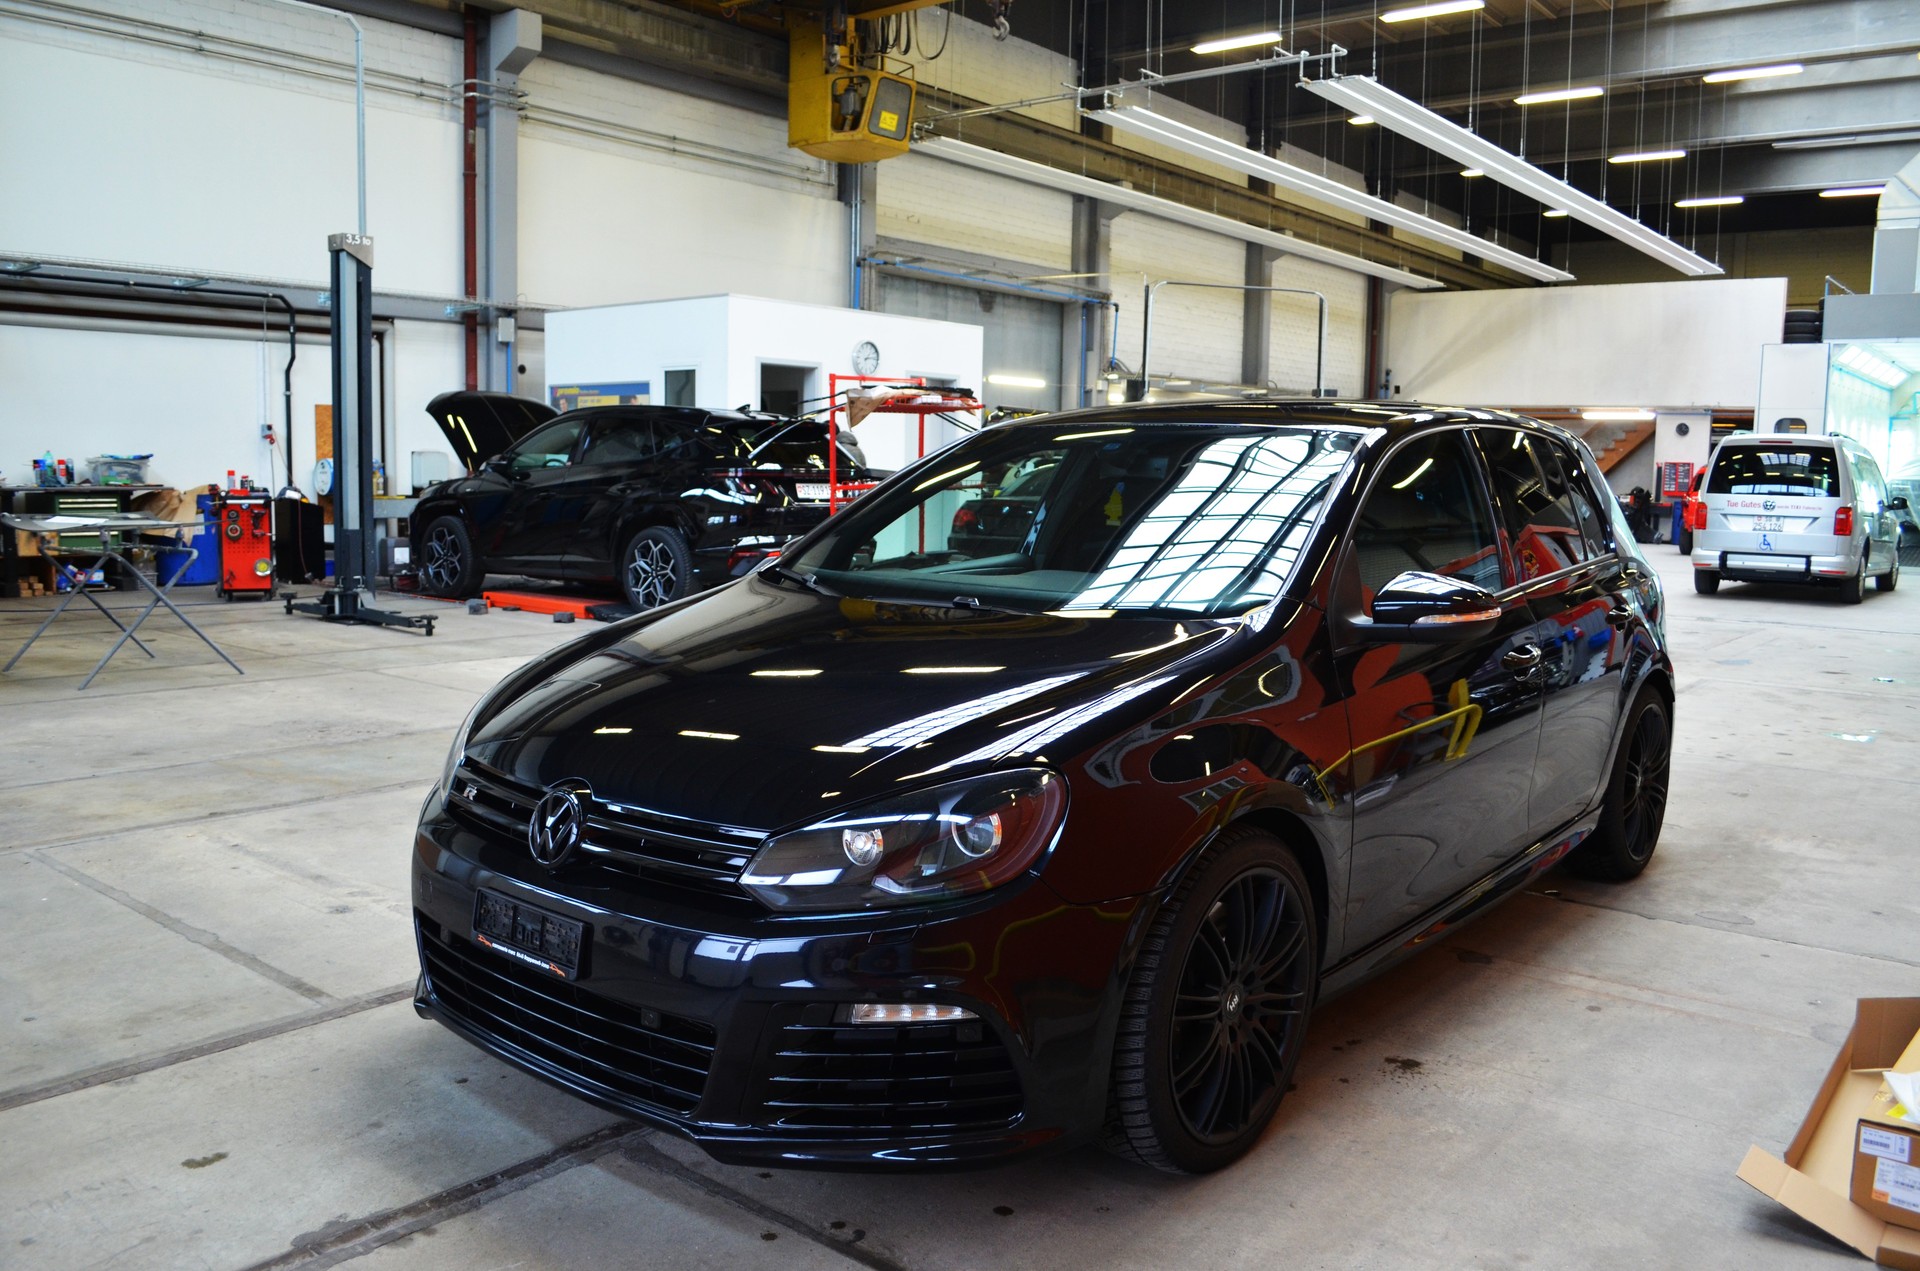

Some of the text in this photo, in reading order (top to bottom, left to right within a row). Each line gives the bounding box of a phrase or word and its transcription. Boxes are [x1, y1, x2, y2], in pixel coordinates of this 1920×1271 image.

[346, 233, 360, 245] 3,5
[1727, 500, 1739, 508] Tue
[1741, 500, 1761, 508] Gutes
